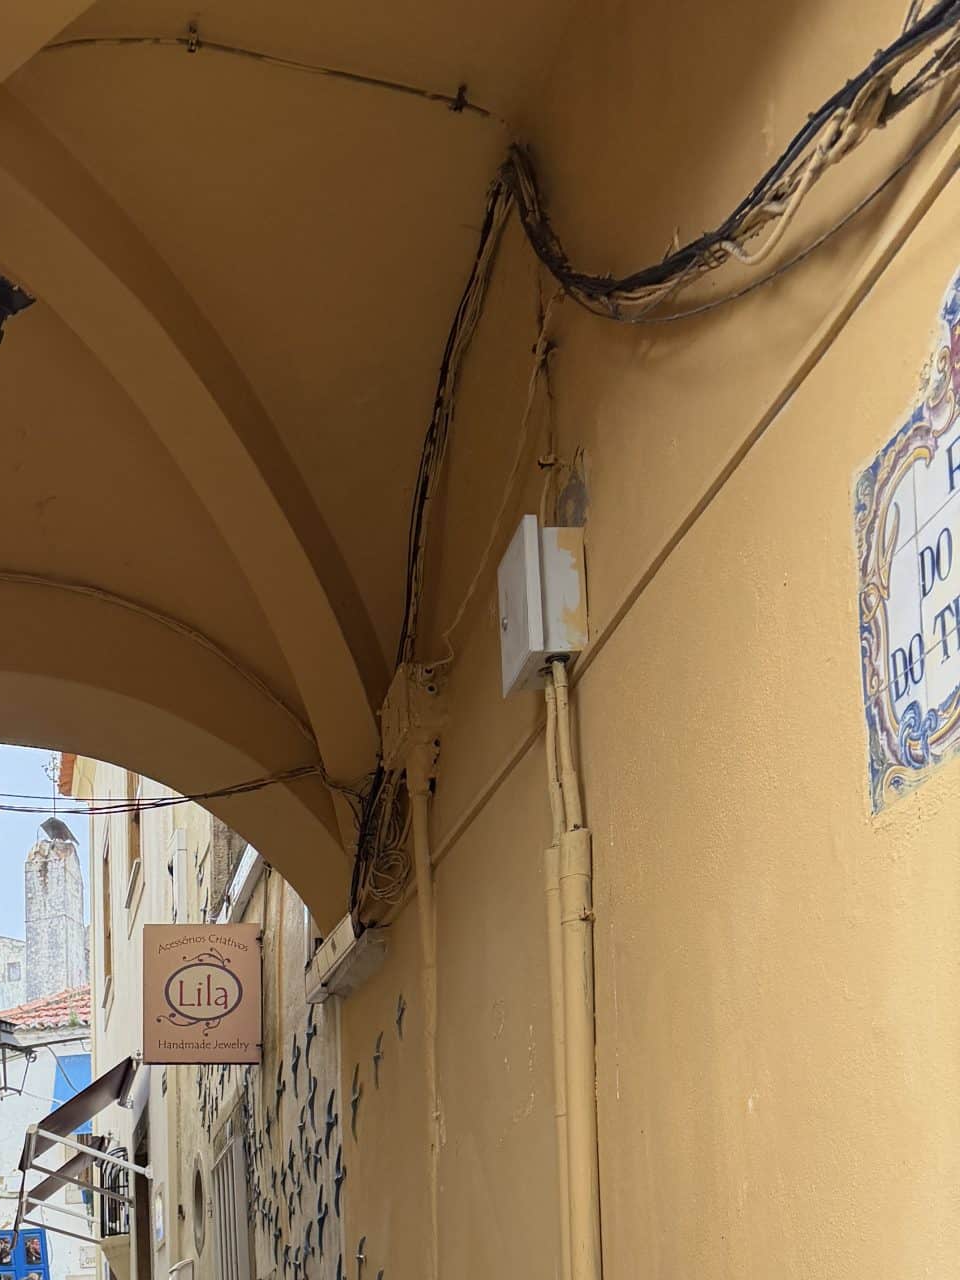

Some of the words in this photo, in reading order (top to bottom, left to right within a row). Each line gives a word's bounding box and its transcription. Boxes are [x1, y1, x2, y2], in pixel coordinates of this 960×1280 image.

[919, 527, 953, 599] DO
[890, 633, 925, 701] DO
[208, 933, 249, 952] Criativos
[179, 974, 228, 1010] Lila
[158, 1039, 212, 1050] Handmade
[214, 1037, 250, 1053] Jewelry
